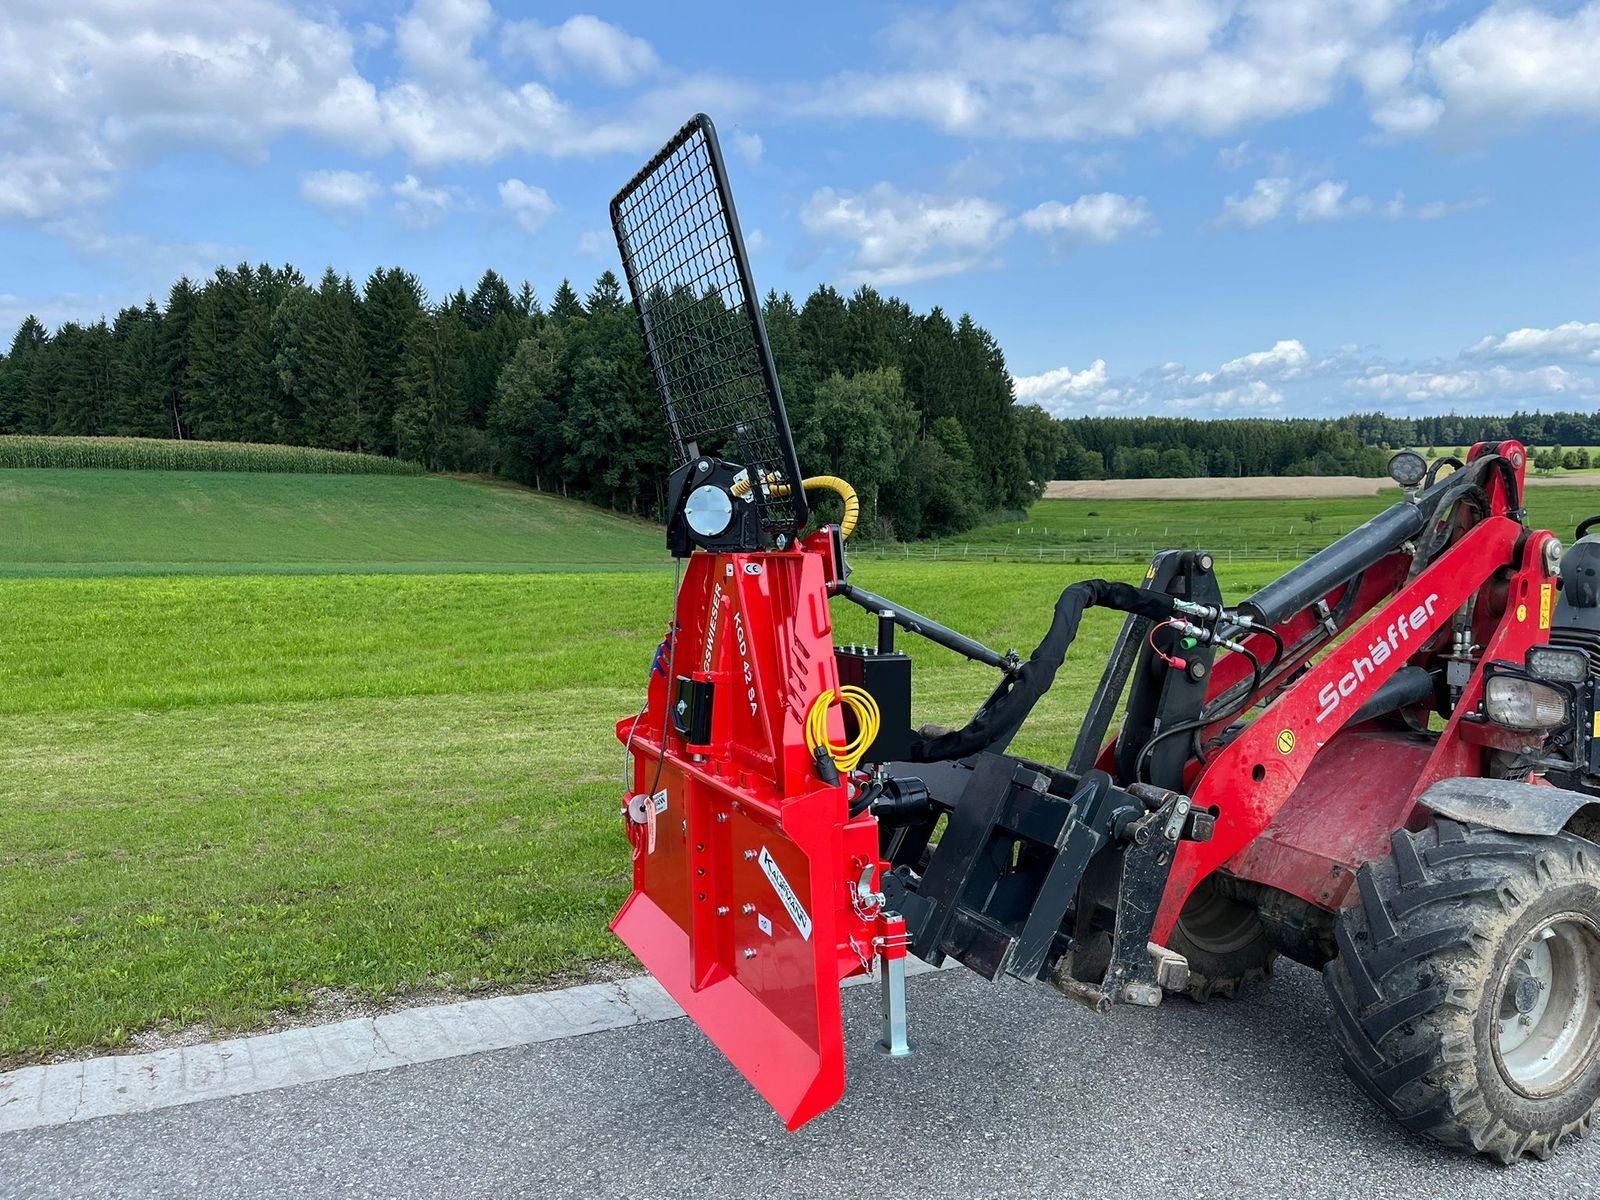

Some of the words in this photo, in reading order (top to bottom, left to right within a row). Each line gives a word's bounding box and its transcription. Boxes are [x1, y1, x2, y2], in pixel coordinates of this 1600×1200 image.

[703, 582, 722, 673] GSWIESER
[734, 612, 747, 656] KGD
[743, 660, 752, 685] 42
[748, 687, 758, 717] SA
[1316, 593, 1439, 724] Schäffer
